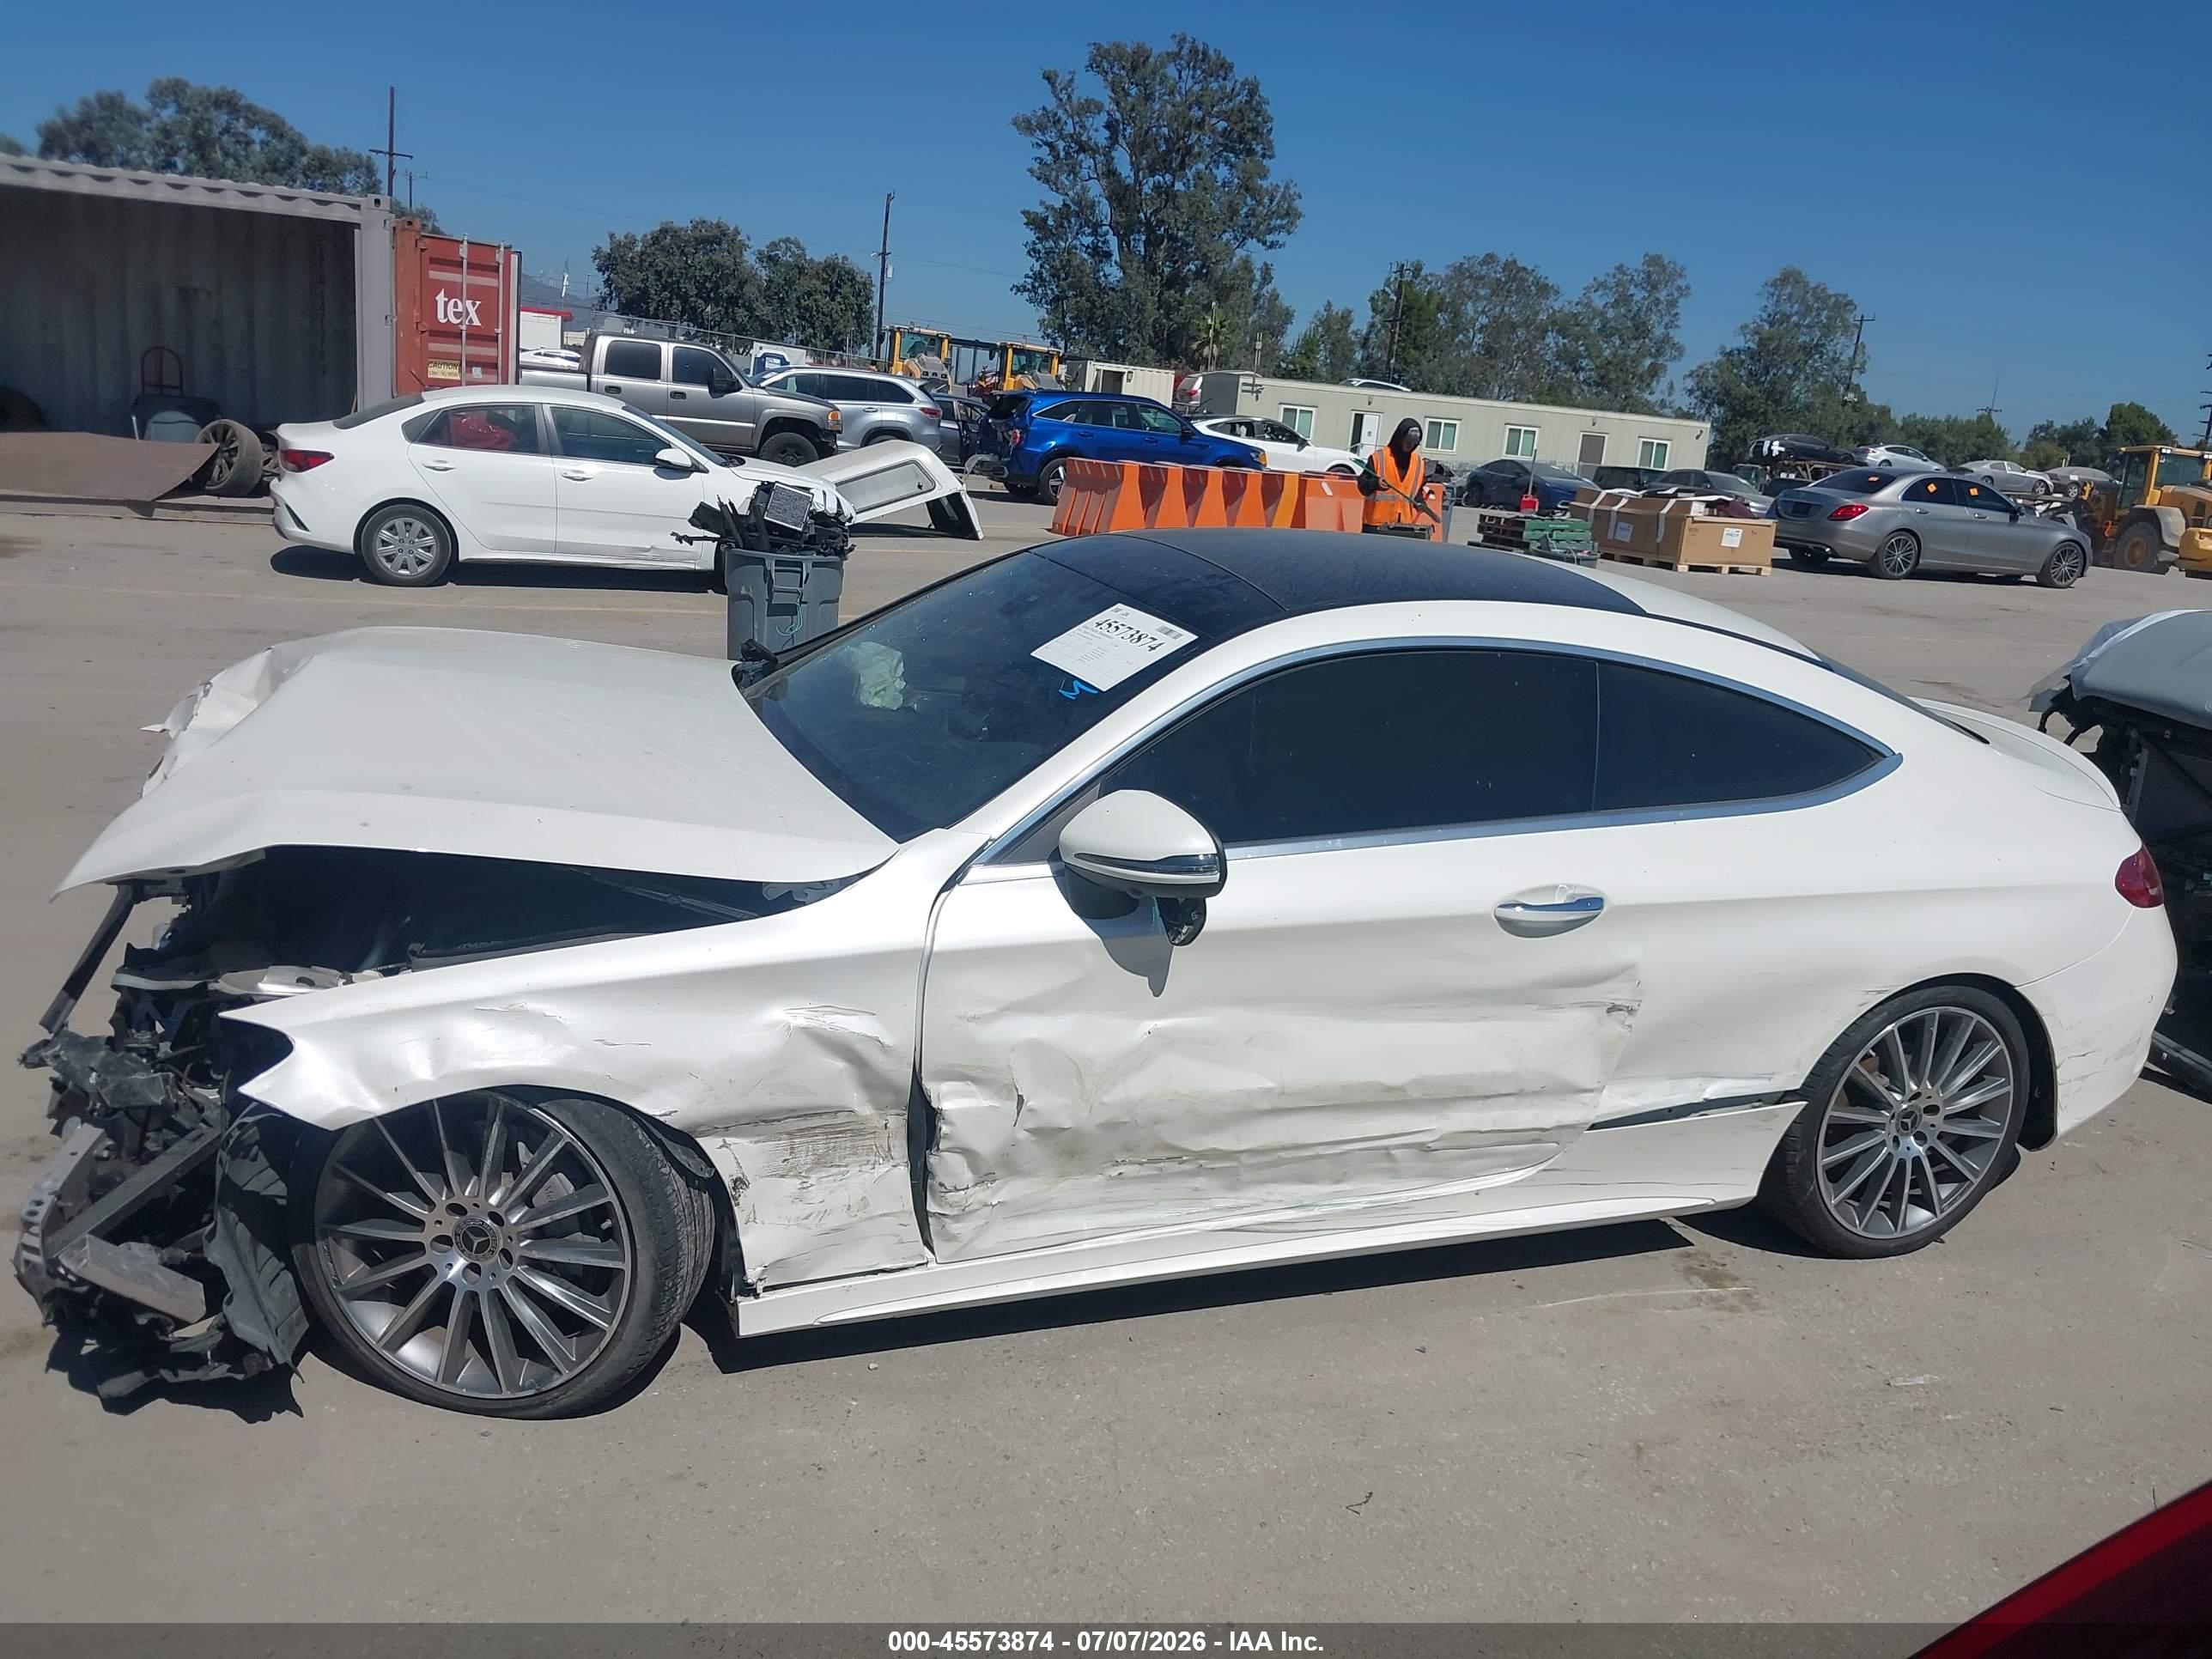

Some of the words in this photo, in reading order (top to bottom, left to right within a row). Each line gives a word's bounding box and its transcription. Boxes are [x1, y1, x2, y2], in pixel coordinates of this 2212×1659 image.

[435, 289, 482, 326] tex
[427, 361, 459, 370] CAUTION
[1094, 618, 1166, 652] 45573874
